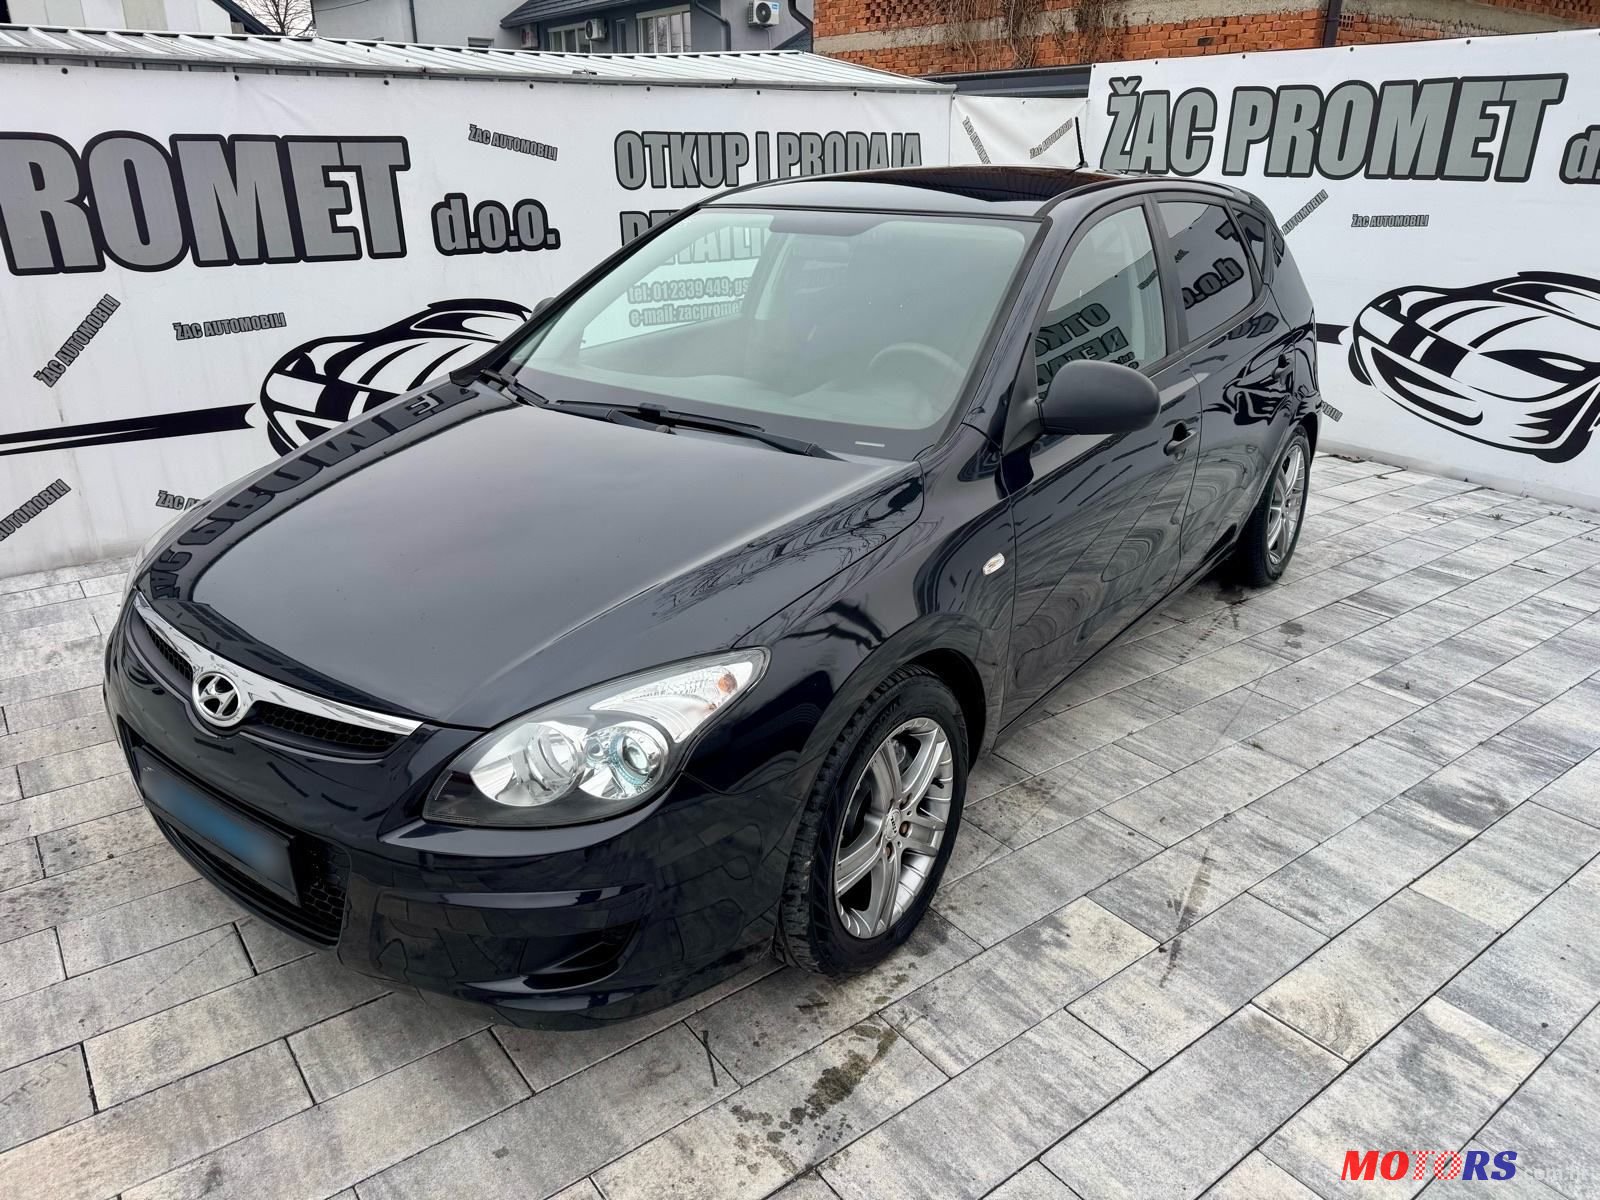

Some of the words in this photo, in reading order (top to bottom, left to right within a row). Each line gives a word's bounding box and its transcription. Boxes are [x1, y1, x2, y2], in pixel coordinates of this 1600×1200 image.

[468, 123, 491, 145] ŽAC
[491, 132, 558, 161] AUTOMOBILI
[1100, 76, 1217, 176] ŽAC
[1222, 73, 1569, 182] PROMET
[614, 130, 749, 190] OTKUP
[755, 131, 770, 182] I
[0, 130, 411, 276] ROMET
[431, 193, 561, 255] d.o.o.
[1281, 188, 1329, 236] AUTOMOBILI
[1351, 213, 1370, 228] ŽAC
[1369, 214, 1430, 228] AUTOMOBILI
[627, 282, 652, 304] tel:
[173, 322, 204, 341] ŽAC
[203, 312, 287, 338] AUTOMOBILI
[629, 304, 678, 327] e-mail:
[33, 360, 67, 389] ŽAC
[55, 293, 121, 367] AUTOMOBILI
[156, 489, 185, 510] ŽAC
